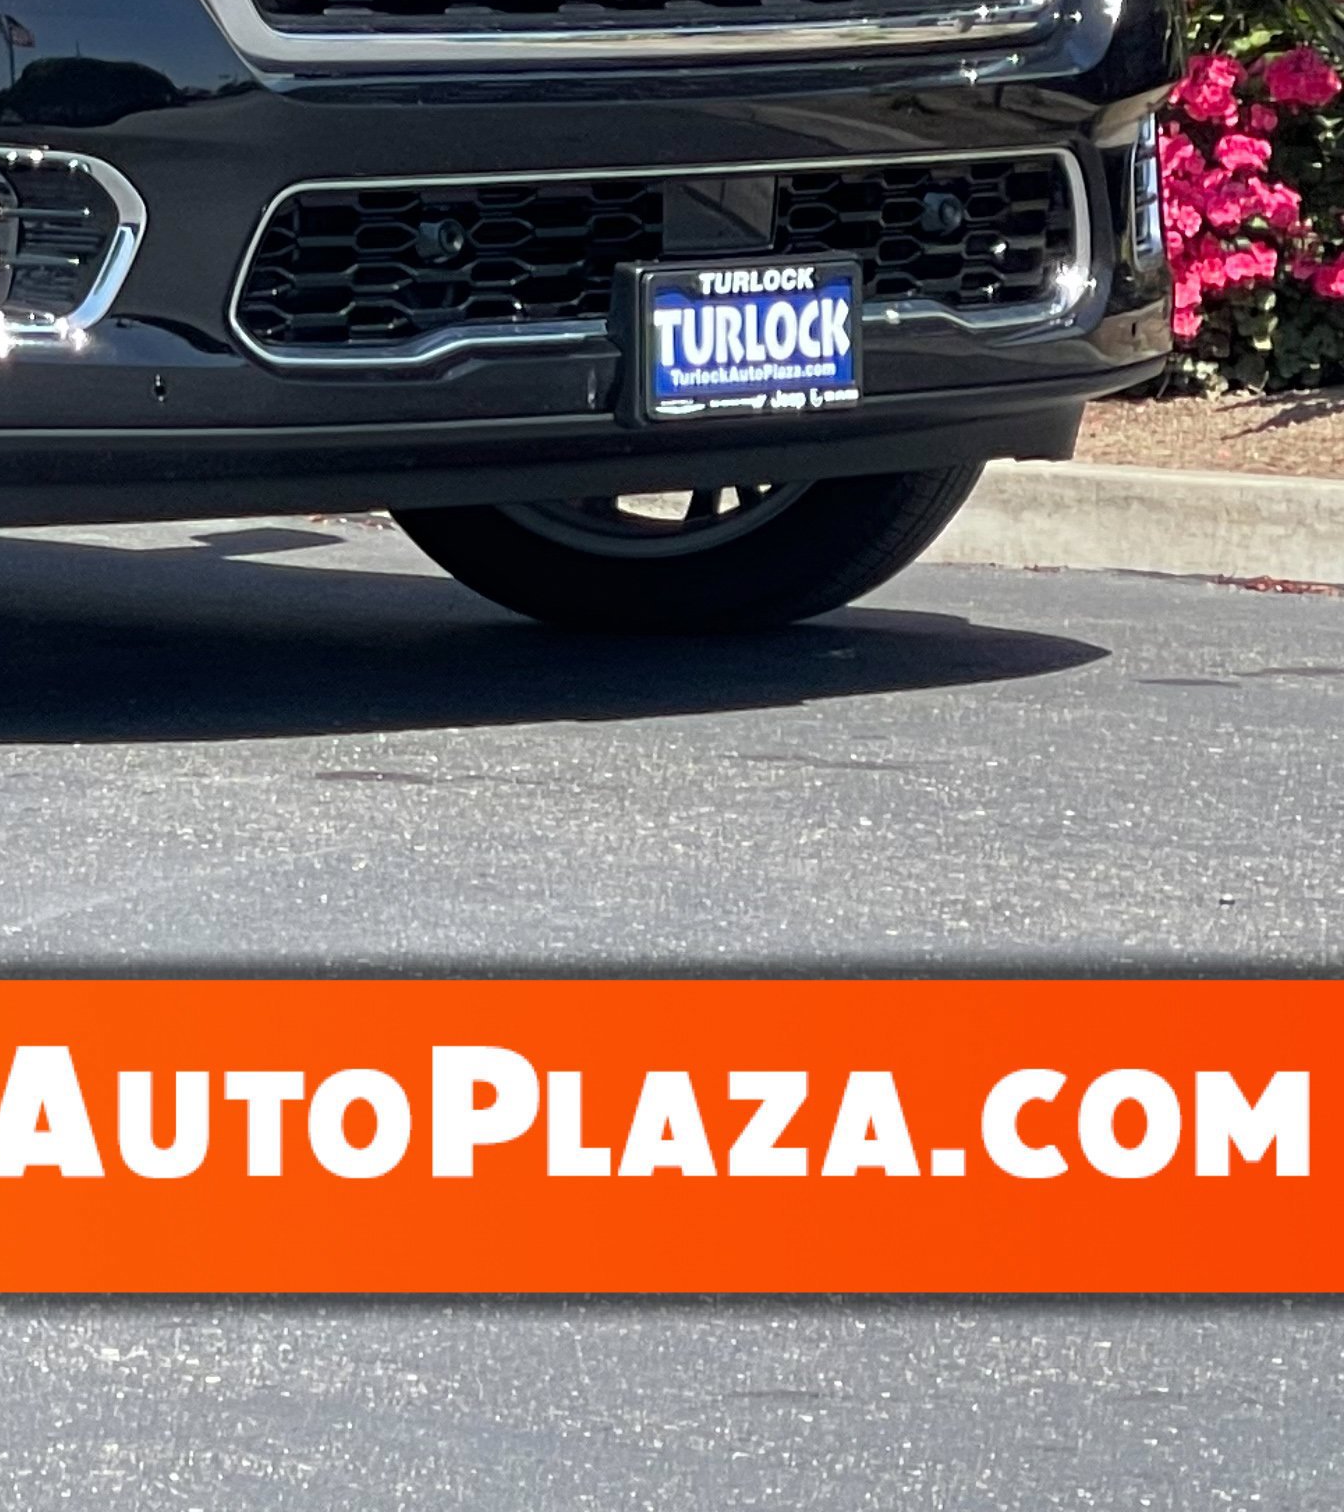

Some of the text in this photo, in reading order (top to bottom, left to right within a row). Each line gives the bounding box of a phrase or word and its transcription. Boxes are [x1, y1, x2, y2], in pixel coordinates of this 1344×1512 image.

[698, 266, 815, 295] TURLOCK
[653, 298, 851, 367] TURLOCK
[670, 363, 837, 388] TurlockAutoPlaza.com
